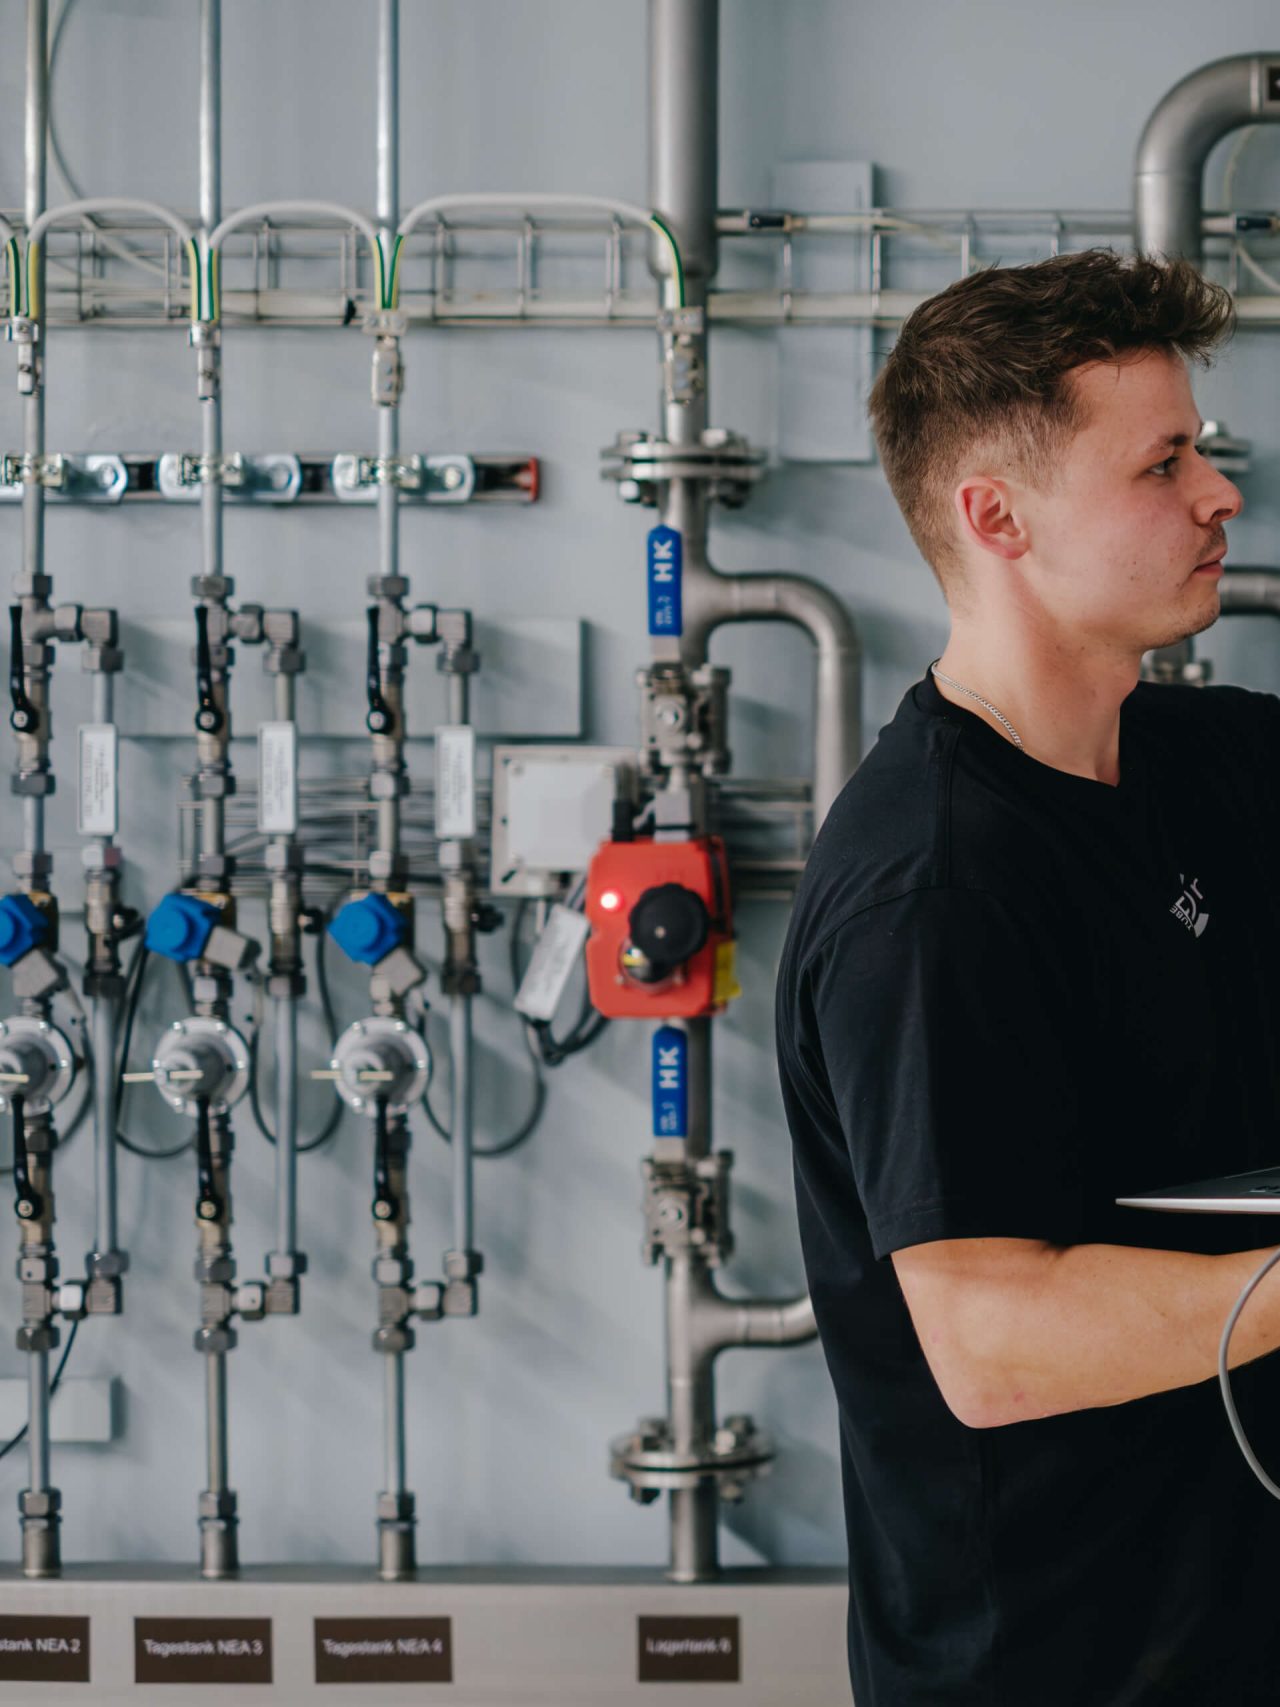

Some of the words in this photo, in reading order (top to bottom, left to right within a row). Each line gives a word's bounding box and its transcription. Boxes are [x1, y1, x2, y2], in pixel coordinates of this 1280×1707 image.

[653, 540, 673, 582] HK
[658, 1046, 679, 1089] HK
[35, 1637, 69, 1653] NEA
[70, 1638, 81, 1654] 2
[217, 1638, 251, 1655] NEA
[251, 1638, 264, 1656] 3
[396, 1638, 431, 1655] NEA
